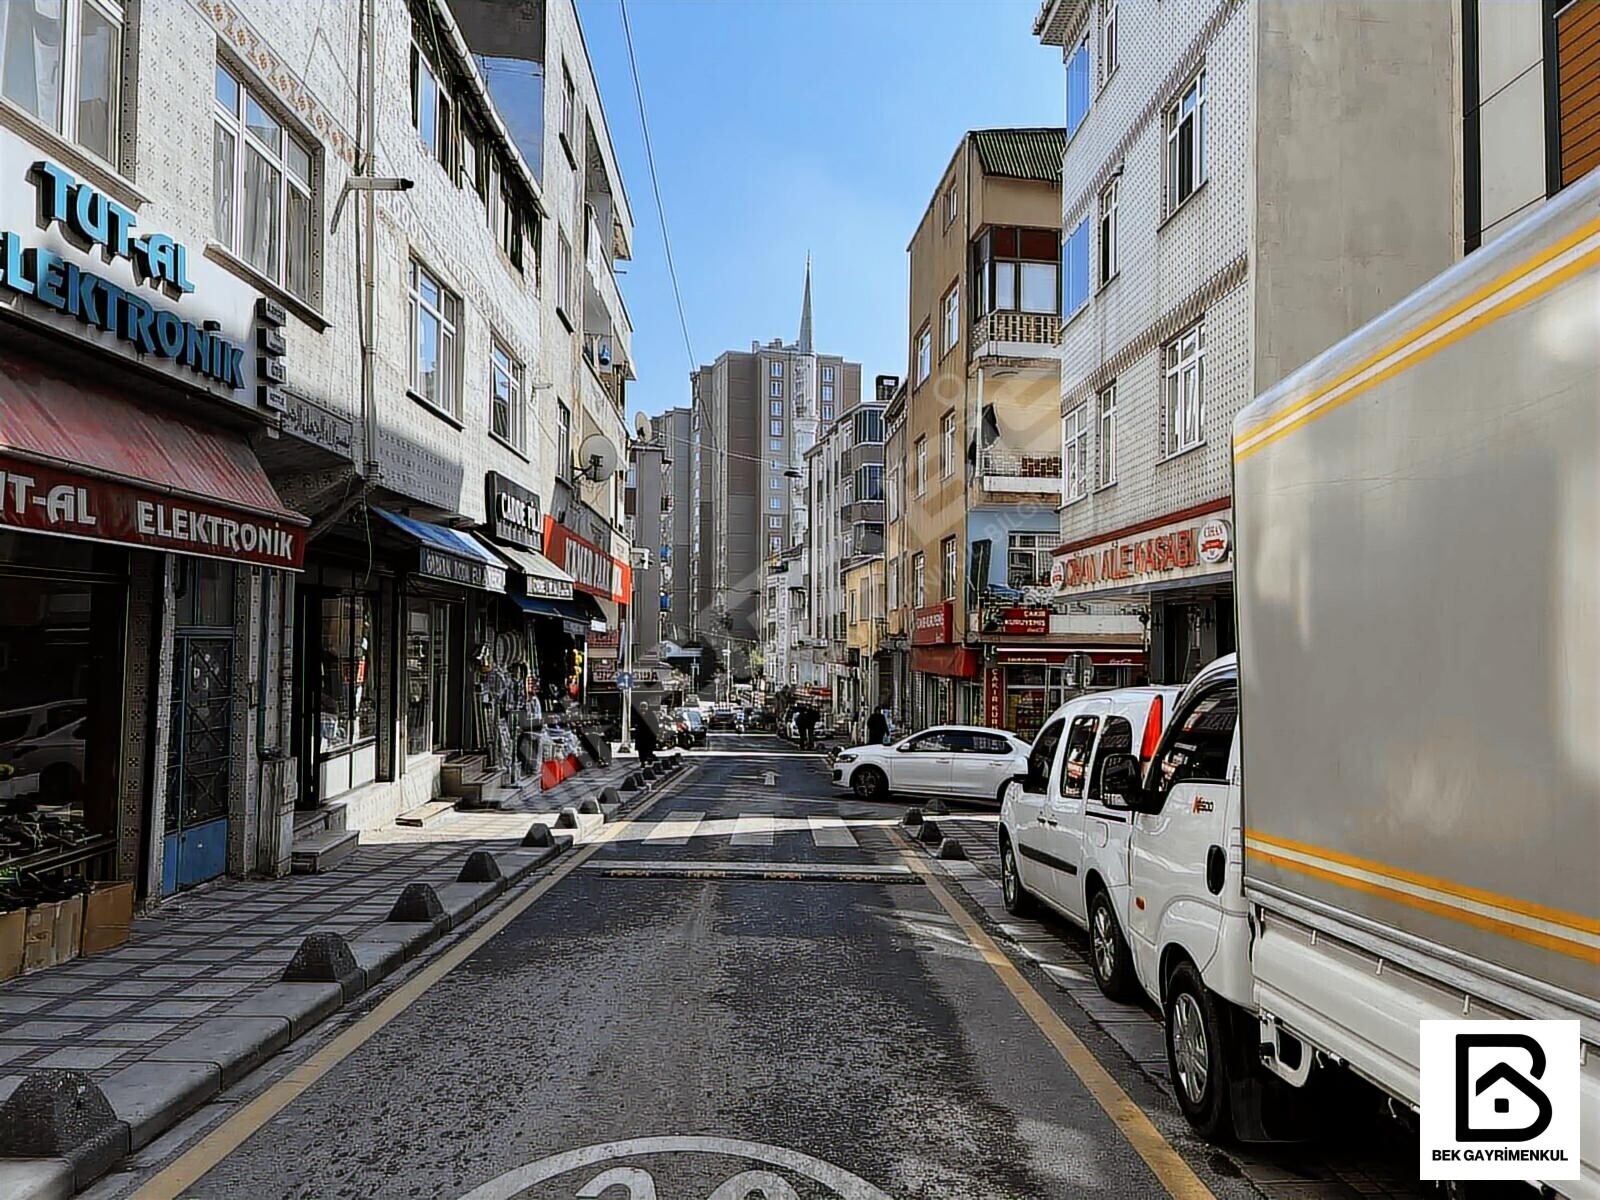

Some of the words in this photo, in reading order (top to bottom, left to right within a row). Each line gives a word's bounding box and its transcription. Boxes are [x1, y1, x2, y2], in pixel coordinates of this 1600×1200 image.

[32, 160, 196, 294] TUT-AL
[0, 230, 246, 391] LEKTRONİK
[136, 499, 294, 561] ELEKTRONİK
